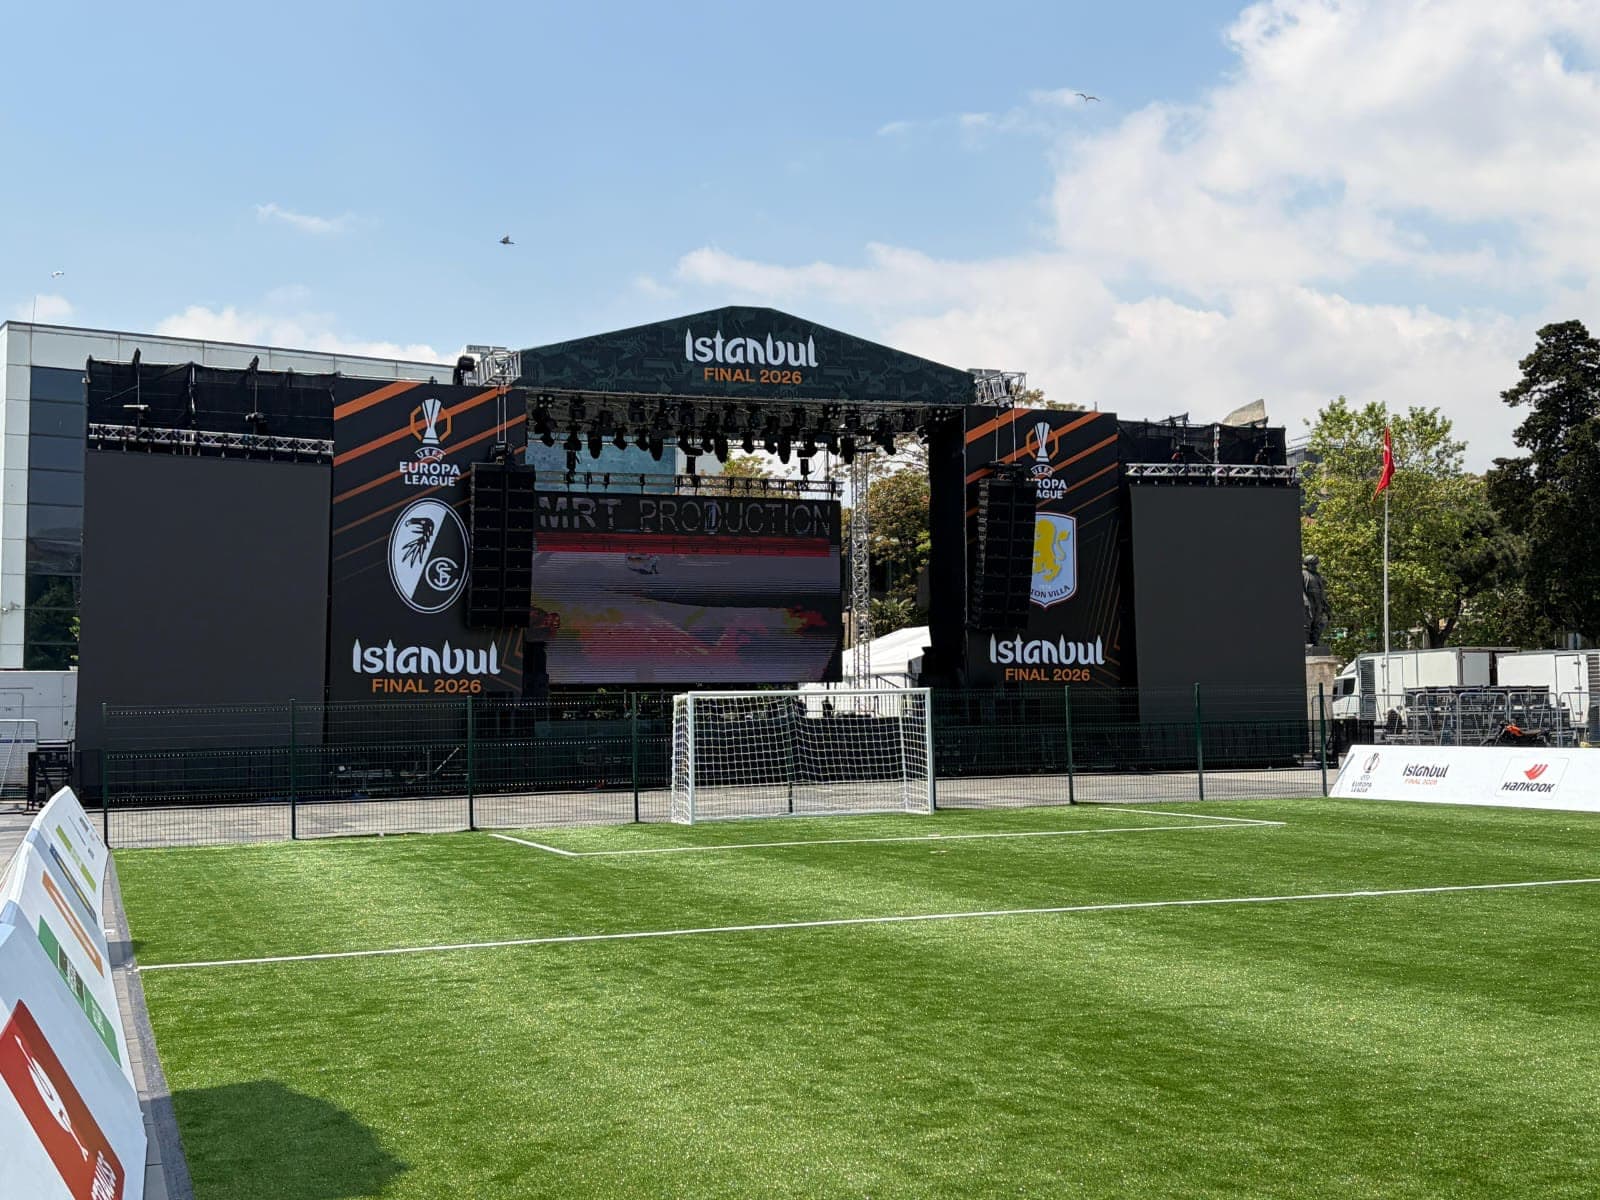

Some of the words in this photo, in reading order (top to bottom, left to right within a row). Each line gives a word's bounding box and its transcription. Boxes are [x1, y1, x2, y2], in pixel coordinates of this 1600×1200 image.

[685, 328, 819, 367] Istanbul
[703, 367, 756, 383] FINAL
[759, 369, 802, 384] 2026
[416, 448, 443, 460] UEFA
[399, 461, 461, 476] EUROPA
[404, 474, 456, 487] LEAGUE
[1036, 489, 1063, 500] AGUE
[538, 496, 621, 530] MRT
[639, 498, 832, 536] PRODUCTION
[352, 638, 500, 675] Istanbul
[989, 633, 1105, 665] Istanbul
[1005, 668, 1050, 681] FINAL
[1053, 668, 1091, 681] 2026
[371, 678, 429, 693] FINAL
[433, 678, 482, 693] 2026
